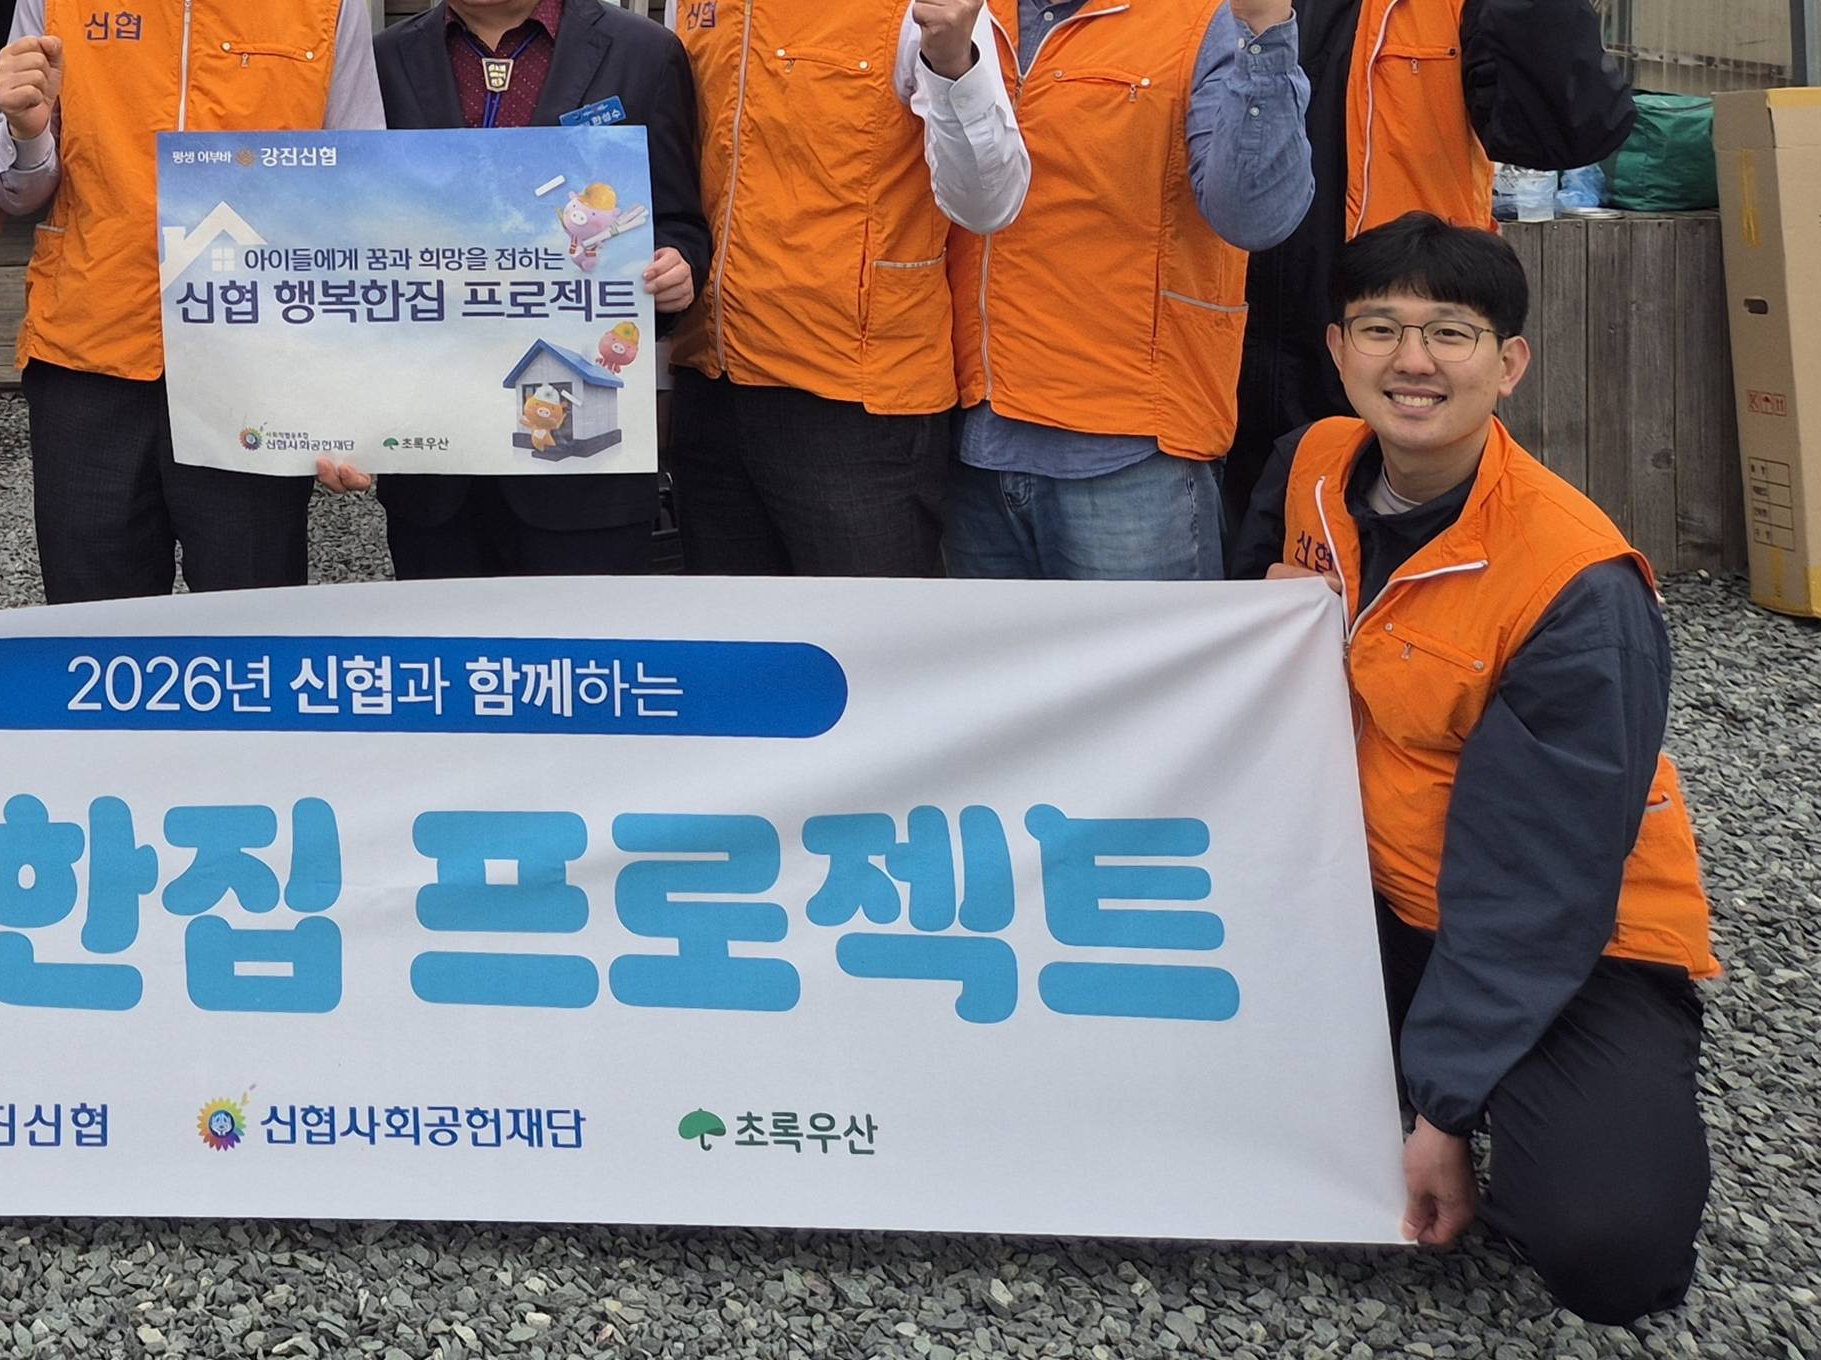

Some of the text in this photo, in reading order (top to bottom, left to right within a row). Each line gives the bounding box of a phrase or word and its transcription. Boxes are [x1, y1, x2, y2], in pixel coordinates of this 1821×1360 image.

[84, 11, 142, 41] 신협
[687, 0, 718, 31] 신협
[172, 146, 338, 167] 평생 어부바 강진신협
[244, 246, 565, 272] 아이들에게 꿈과 희망을 전하는
[176, 278, 640, 326] 신협 행복한집 프로젝트
[266, 439, 355, 451] 신협사회공헌재단
[402, 437, 449, 451] 초록우산
[67, 655, 684, 719] 2026년 신협과 함께하는
[409, 802, 1241, 1024] 프로젝트
[260, 1104, 586, 1151] 신협사회공헌재단
[734, 1110, 879, 1156] 초록우산
